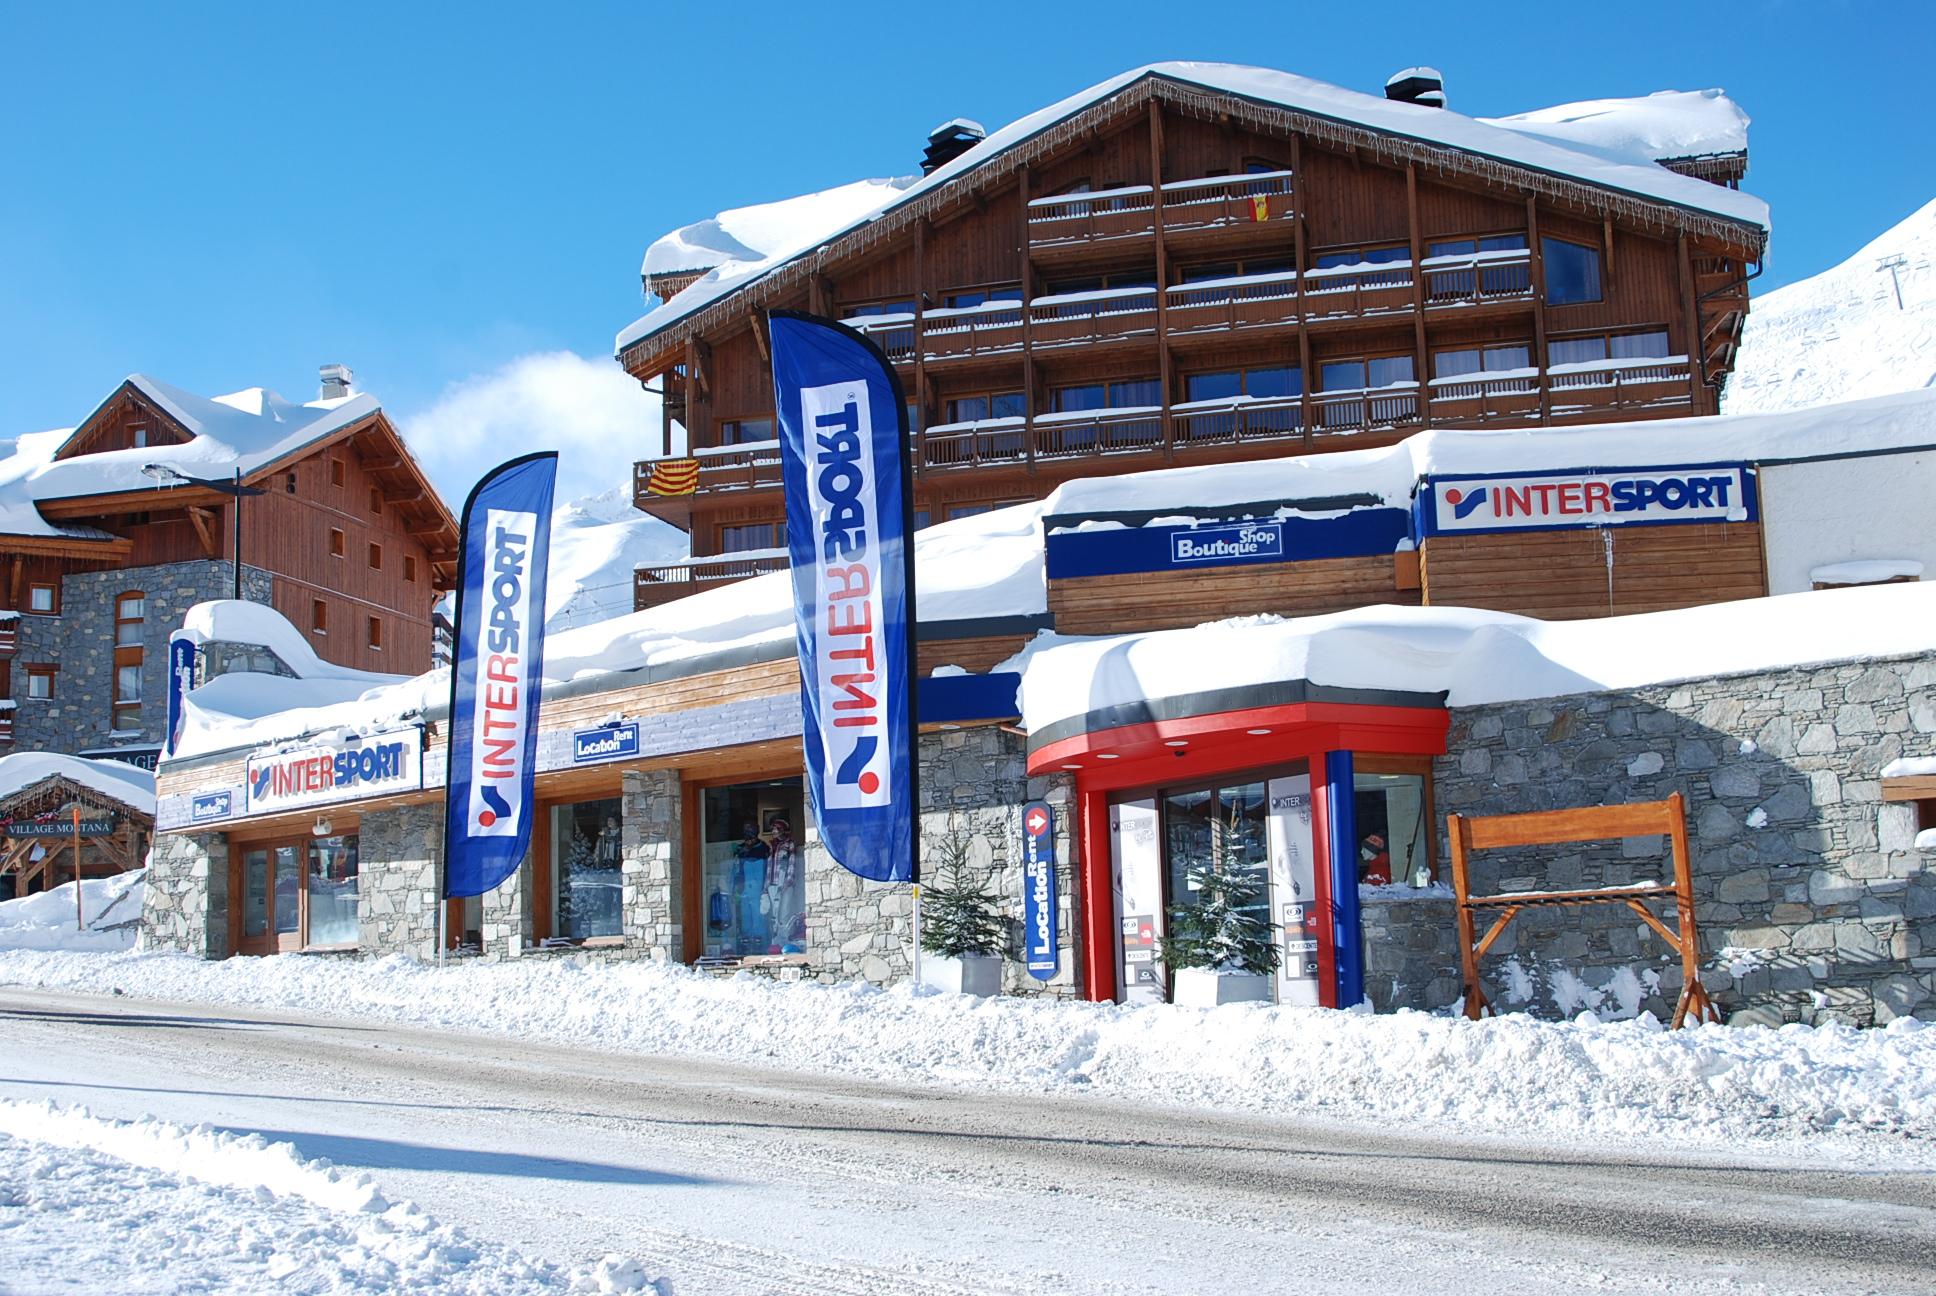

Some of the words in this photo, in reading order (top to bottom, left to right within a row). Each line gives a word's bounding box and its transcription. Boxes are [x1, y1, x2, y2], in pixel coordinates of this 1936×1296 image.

[1492, 475, 1733, 518] INTERSPORT
[1177, 539, 1258, 558] Boutique
[1239, 529, 1276, 545] Shop
[481, 526, 528, 779] INTERSPORT
[577, 738, 621, 756] Location
[613, 730, 633, 742] Rent
[272, 741, 404, 797] INTERSPORT
[9, 824, 55, 835] VILLAGE
[56, 823, 110, 834] MOTANA
[1027, 834, 1038, 878] Rent
[1032, 861, 1051, 955] Location
